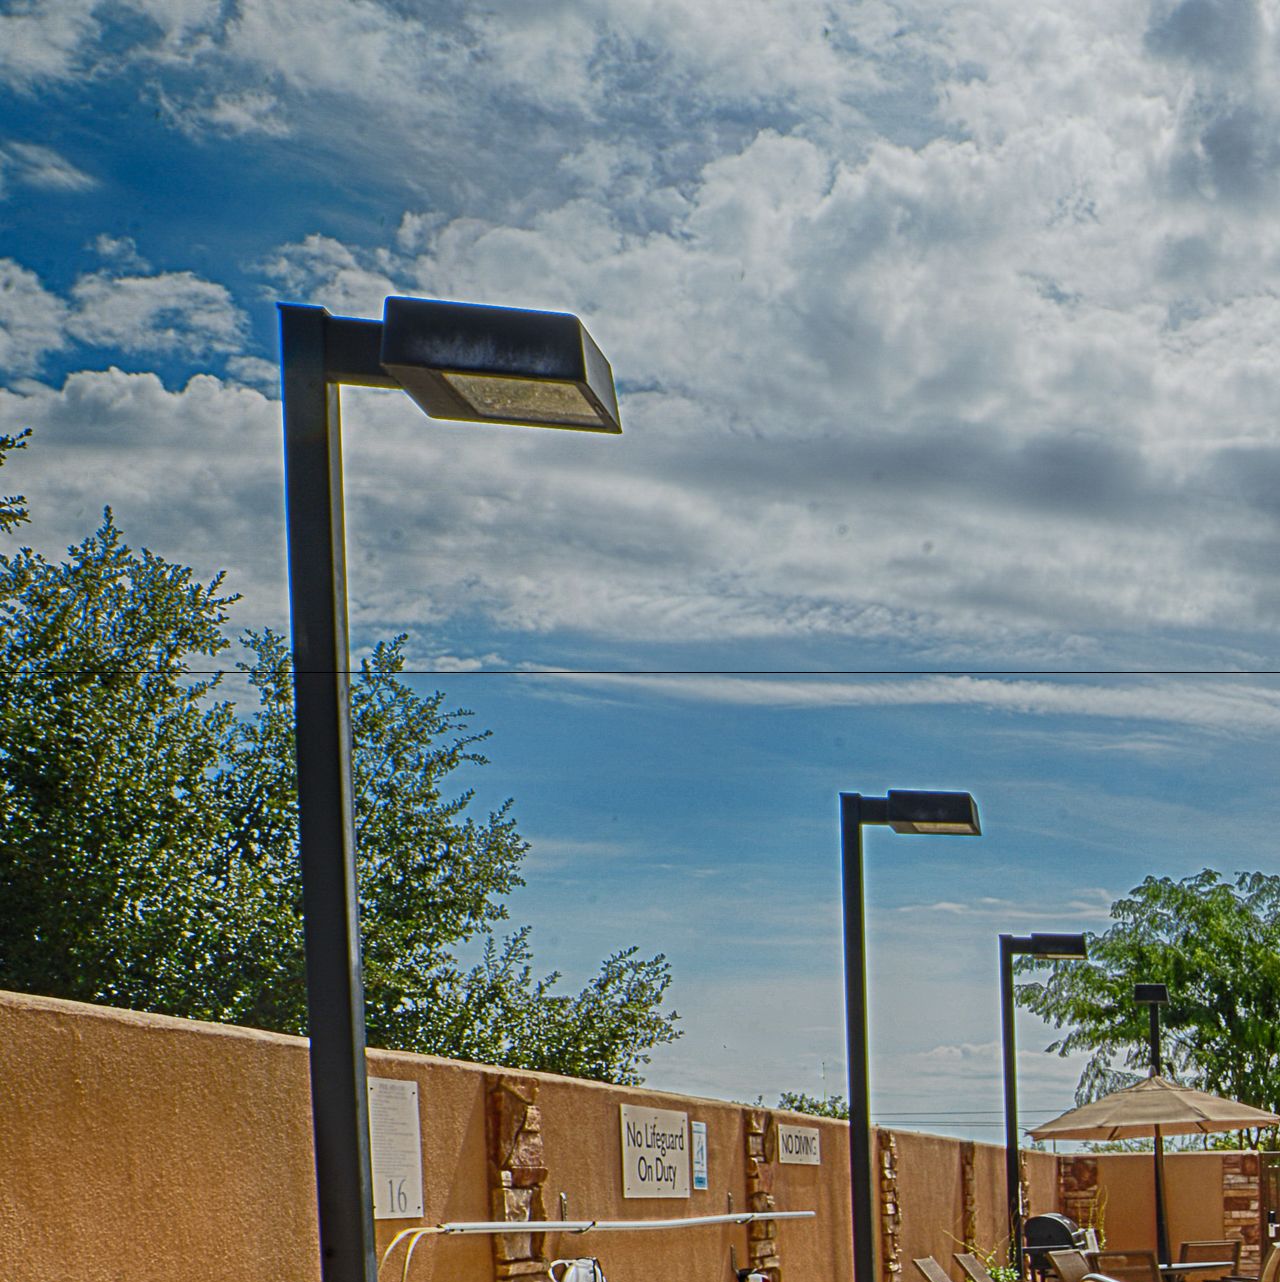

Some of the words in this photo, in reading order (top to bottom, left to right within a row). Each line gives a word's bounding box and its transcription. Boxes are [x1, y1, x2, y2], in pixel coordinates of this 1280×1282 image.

[626, 1121, 643, 1148] No
[645, 1123, 684, 1157] Lifeguard
[781, 1133, 793, 1154] NO
[794, 1135, 817, 1156] DIVING
[638, 1156, 653, 1182] On
[655, 1157, 677, 1190] Duty
[388, 1179, 408, 1213] 16
